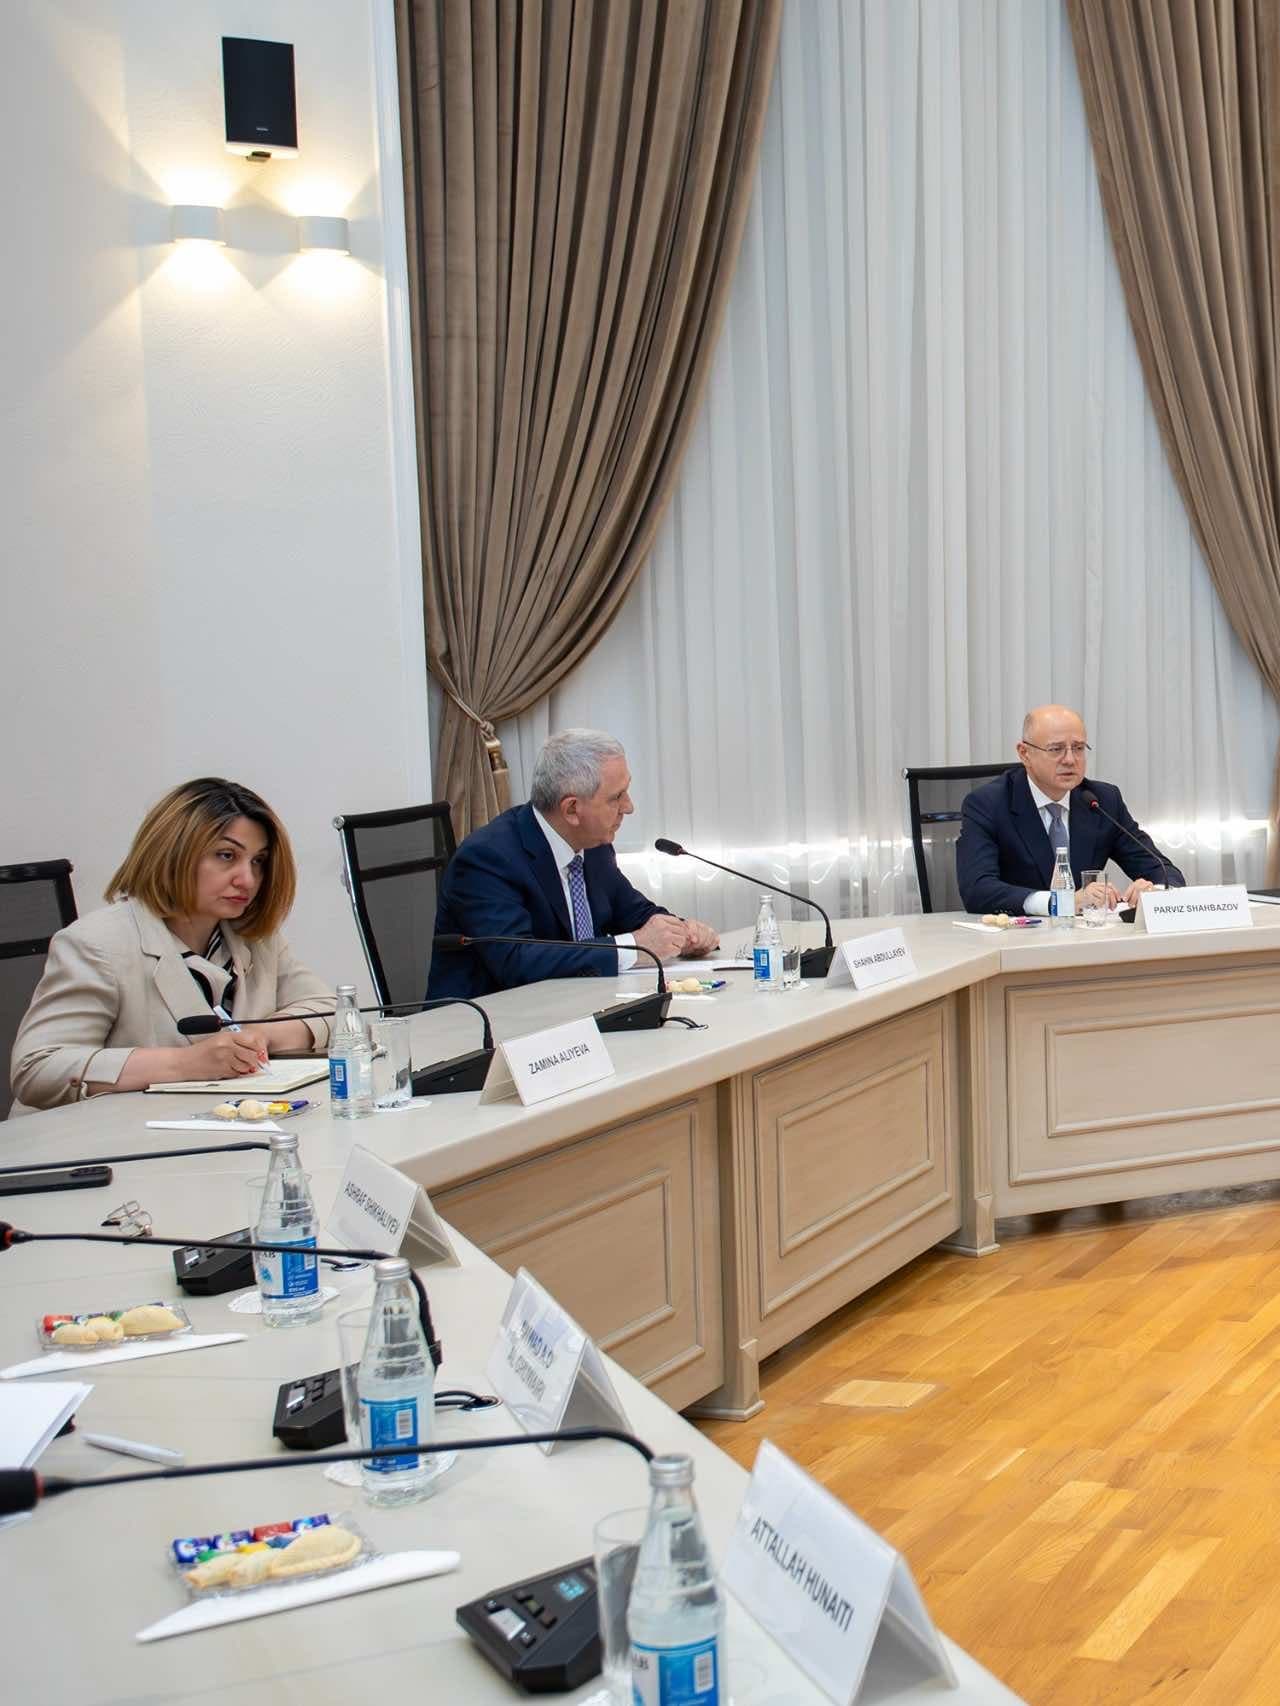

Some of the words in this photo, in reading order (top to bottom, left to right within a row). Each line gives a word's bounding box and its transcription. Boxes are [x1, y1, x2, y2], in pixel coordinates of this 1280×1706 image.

[1153, 905, 1185, 914] PARVIZ
[1186, 903, 1239, 913] SHAHBAZOV
[873, 946, 906, 963] ABDULLAYEV
[528, 1054, 561, 1075] ZAMINA
[559, 1043, 591, 1063] ALIYEVA
[750, 1516, 808, 1585] ATTALLAH
[803, 1566, 856, 1633] HUNAITI
